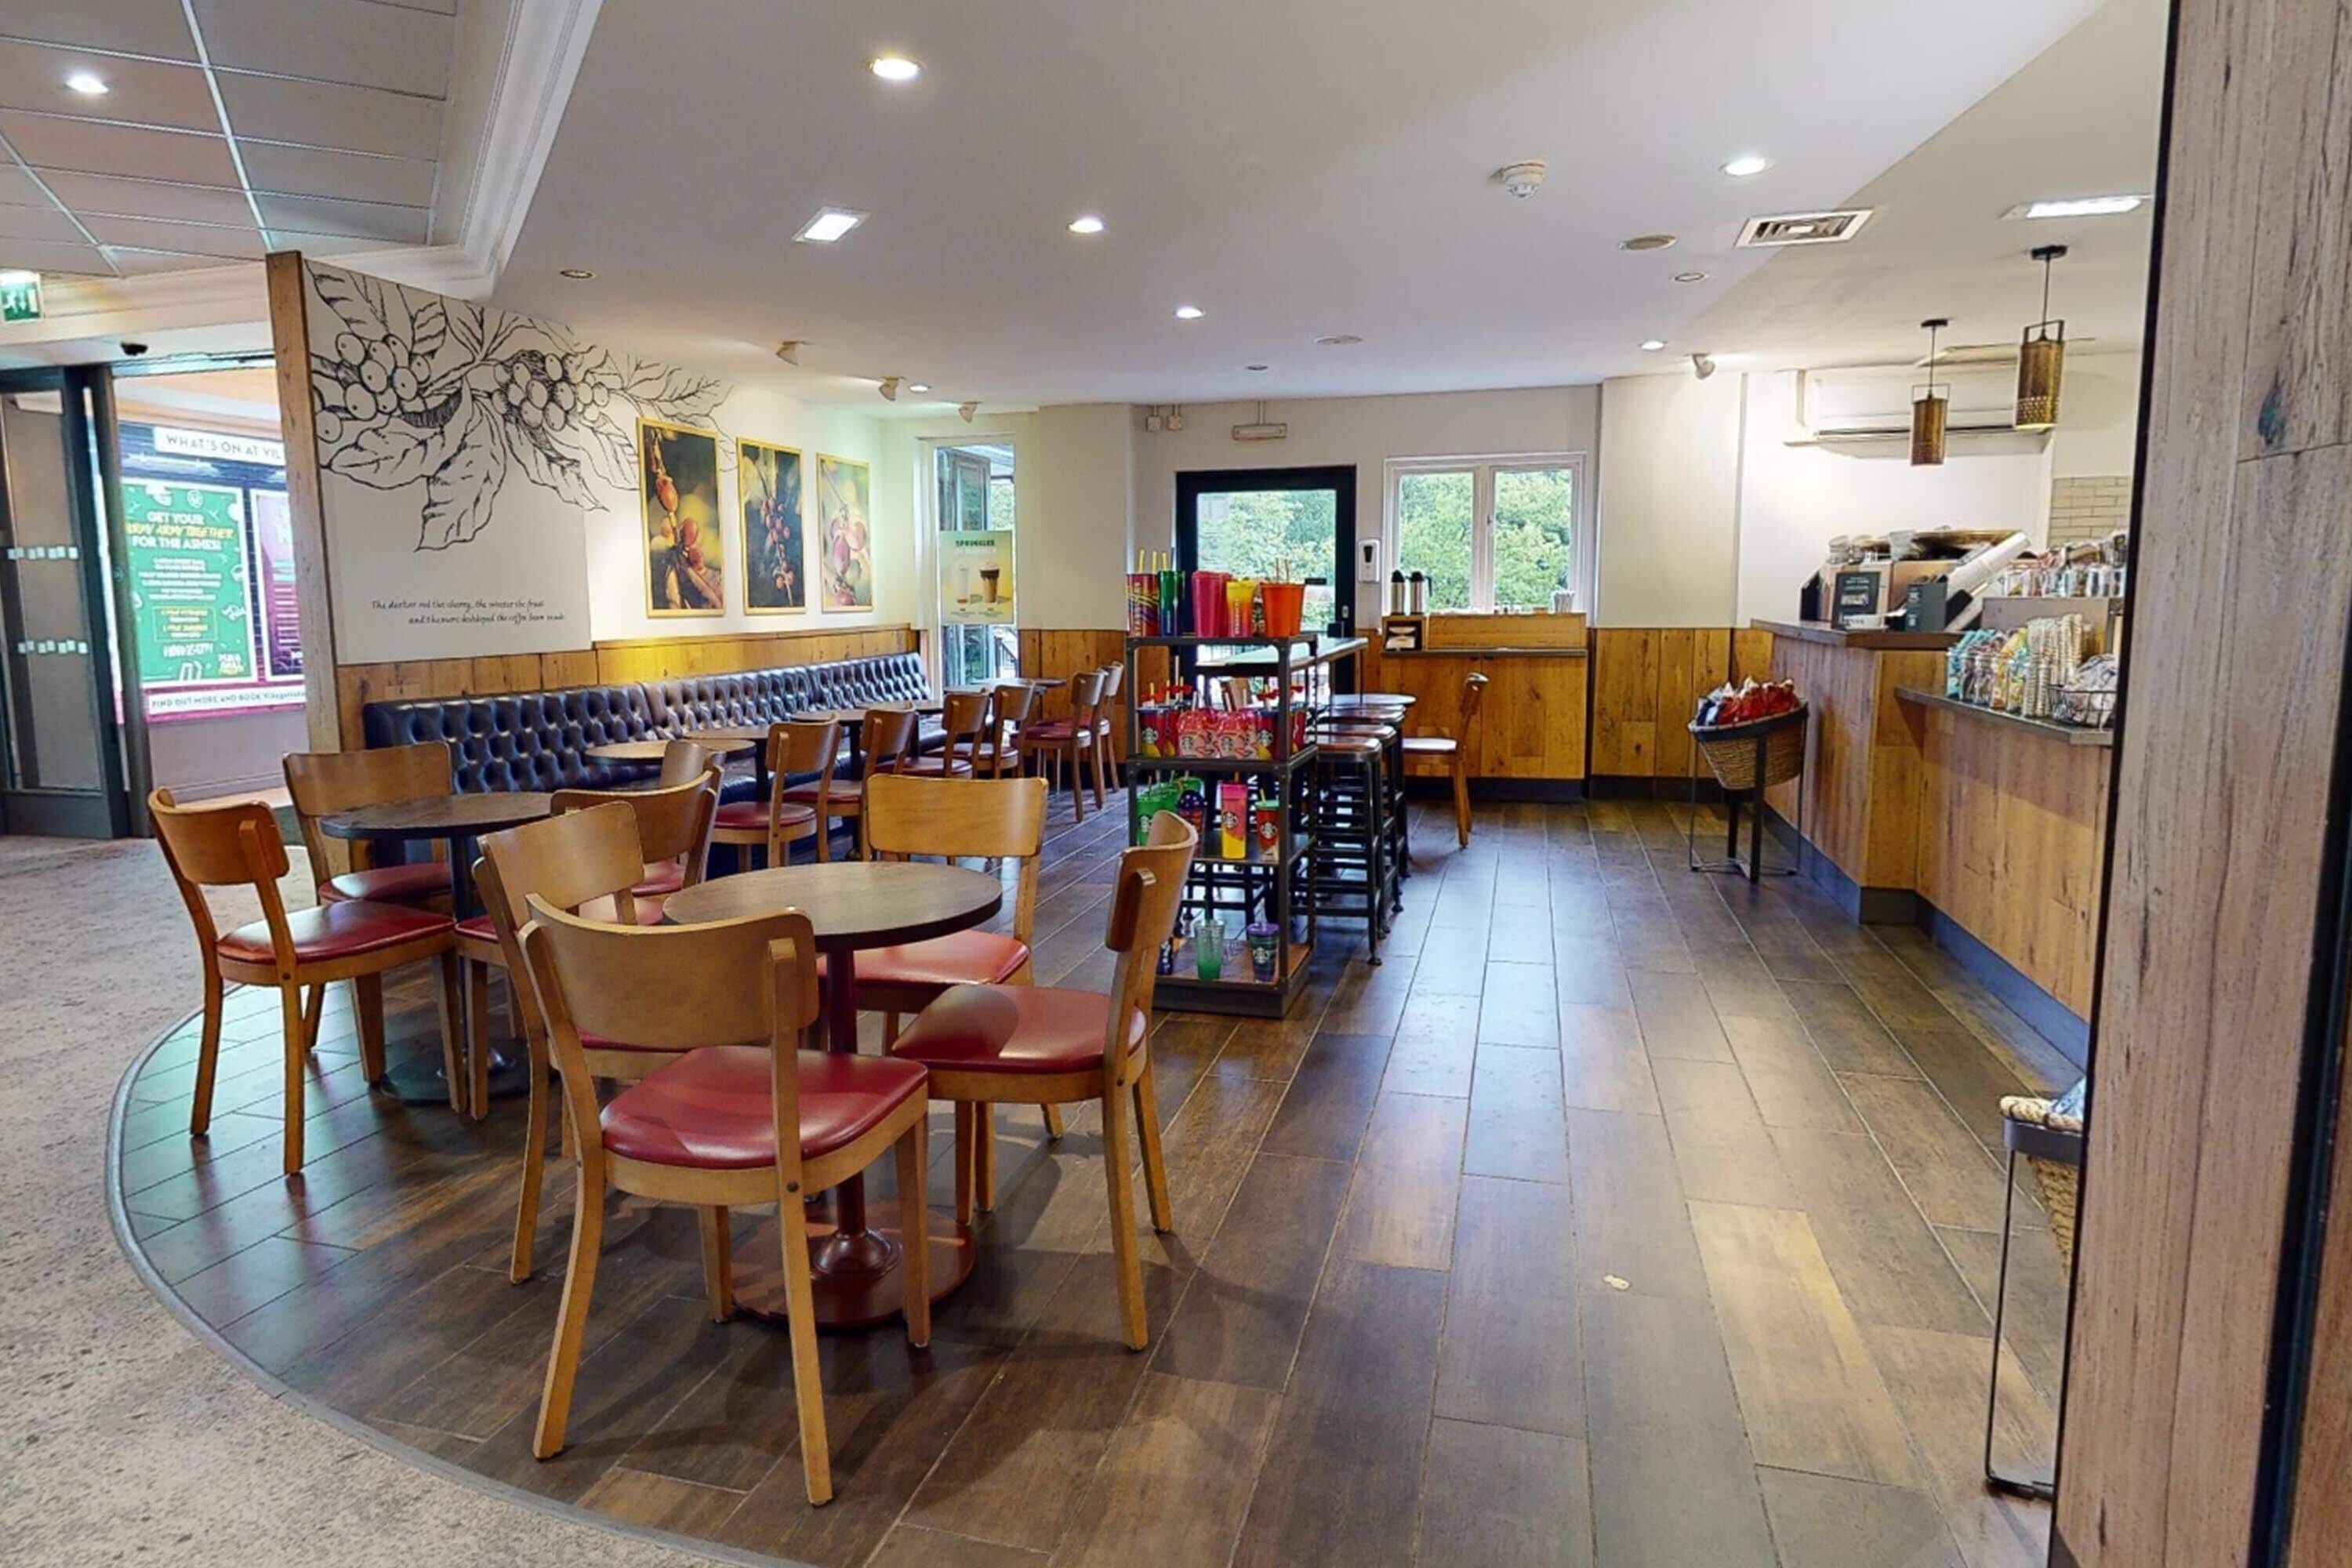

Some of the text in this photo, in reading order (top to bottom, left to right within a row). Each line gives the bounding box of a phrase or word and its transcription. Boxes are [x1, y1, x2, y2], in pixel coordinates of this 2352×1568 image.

[166, 435, 216, 452] WHAT'S
[220, 441, 241, 453] ON
[245, 445, 259, 456] AT
[147, 511, 205, 525] GET YOUR
[132, 535, 157, 547] FOR
[158, 536, 181, 549] THE
[372, 600, 386, 609] The
[152, 699, 172, 708] FIND
[175, 698, 191, 706] OUT
[194, 695, 218, 705] MORE
[220, 694, 237, 702] AND
[239, 691, 260, 702] BOOK
